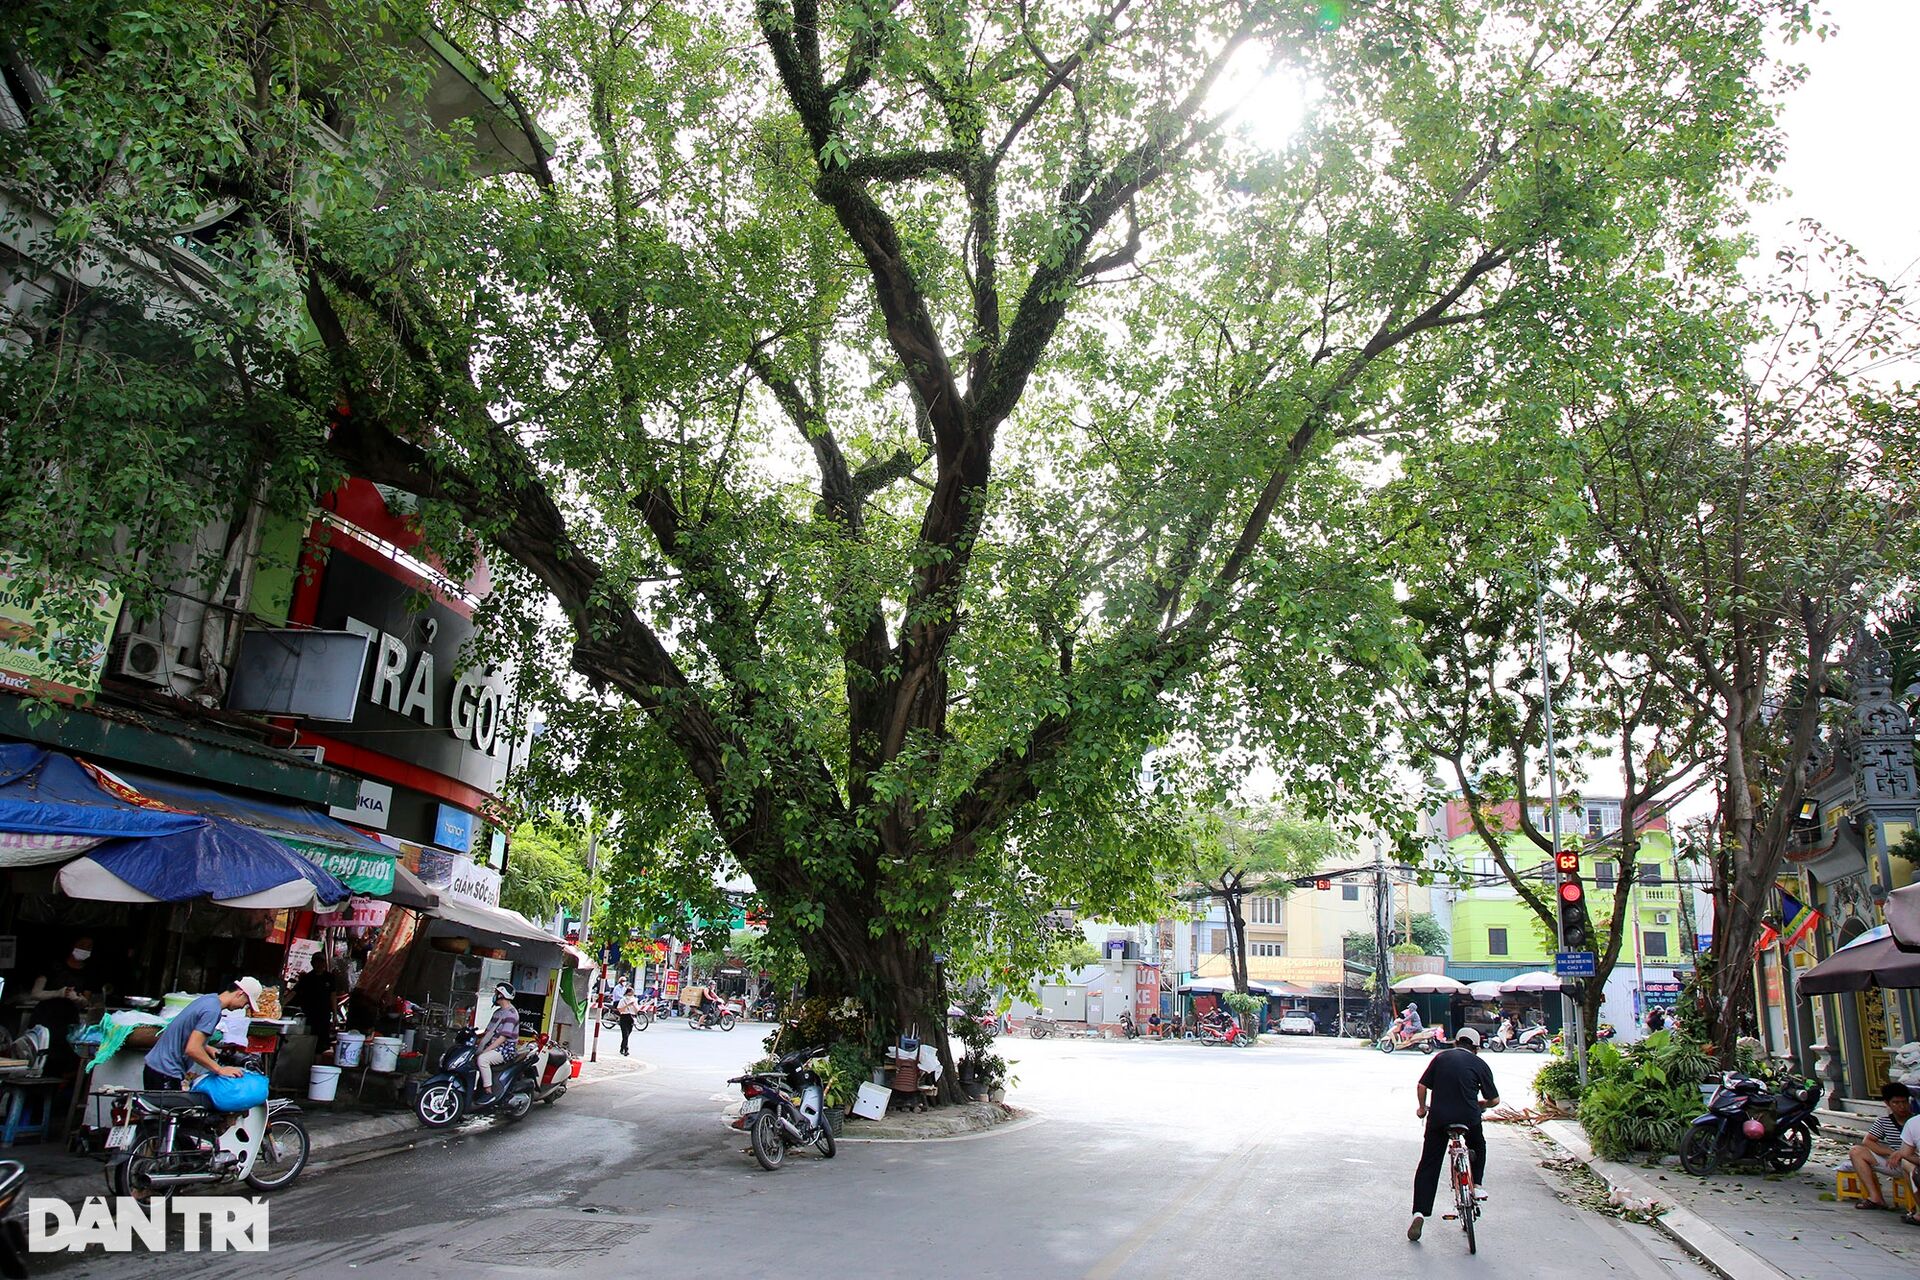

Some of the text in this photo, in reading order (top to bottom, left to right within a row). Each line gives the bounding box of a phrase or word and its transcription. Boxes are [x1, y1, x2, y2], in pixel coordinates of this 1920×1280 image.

[346, 616, 434, 726] TRẢ
[357, 795, 384, 813] KIA
[444, 820, 465, 837] honor
[327, 855, 359, 879] CHỢ
[357, 856, 391, 881] BƯỞI
[1560, 856, 1576, 869] 62
[454, 875, 474, 897] GIẢM
[473, 877, 488, 902] SỐC
[1137, 965, 1157, 985] ỬA
